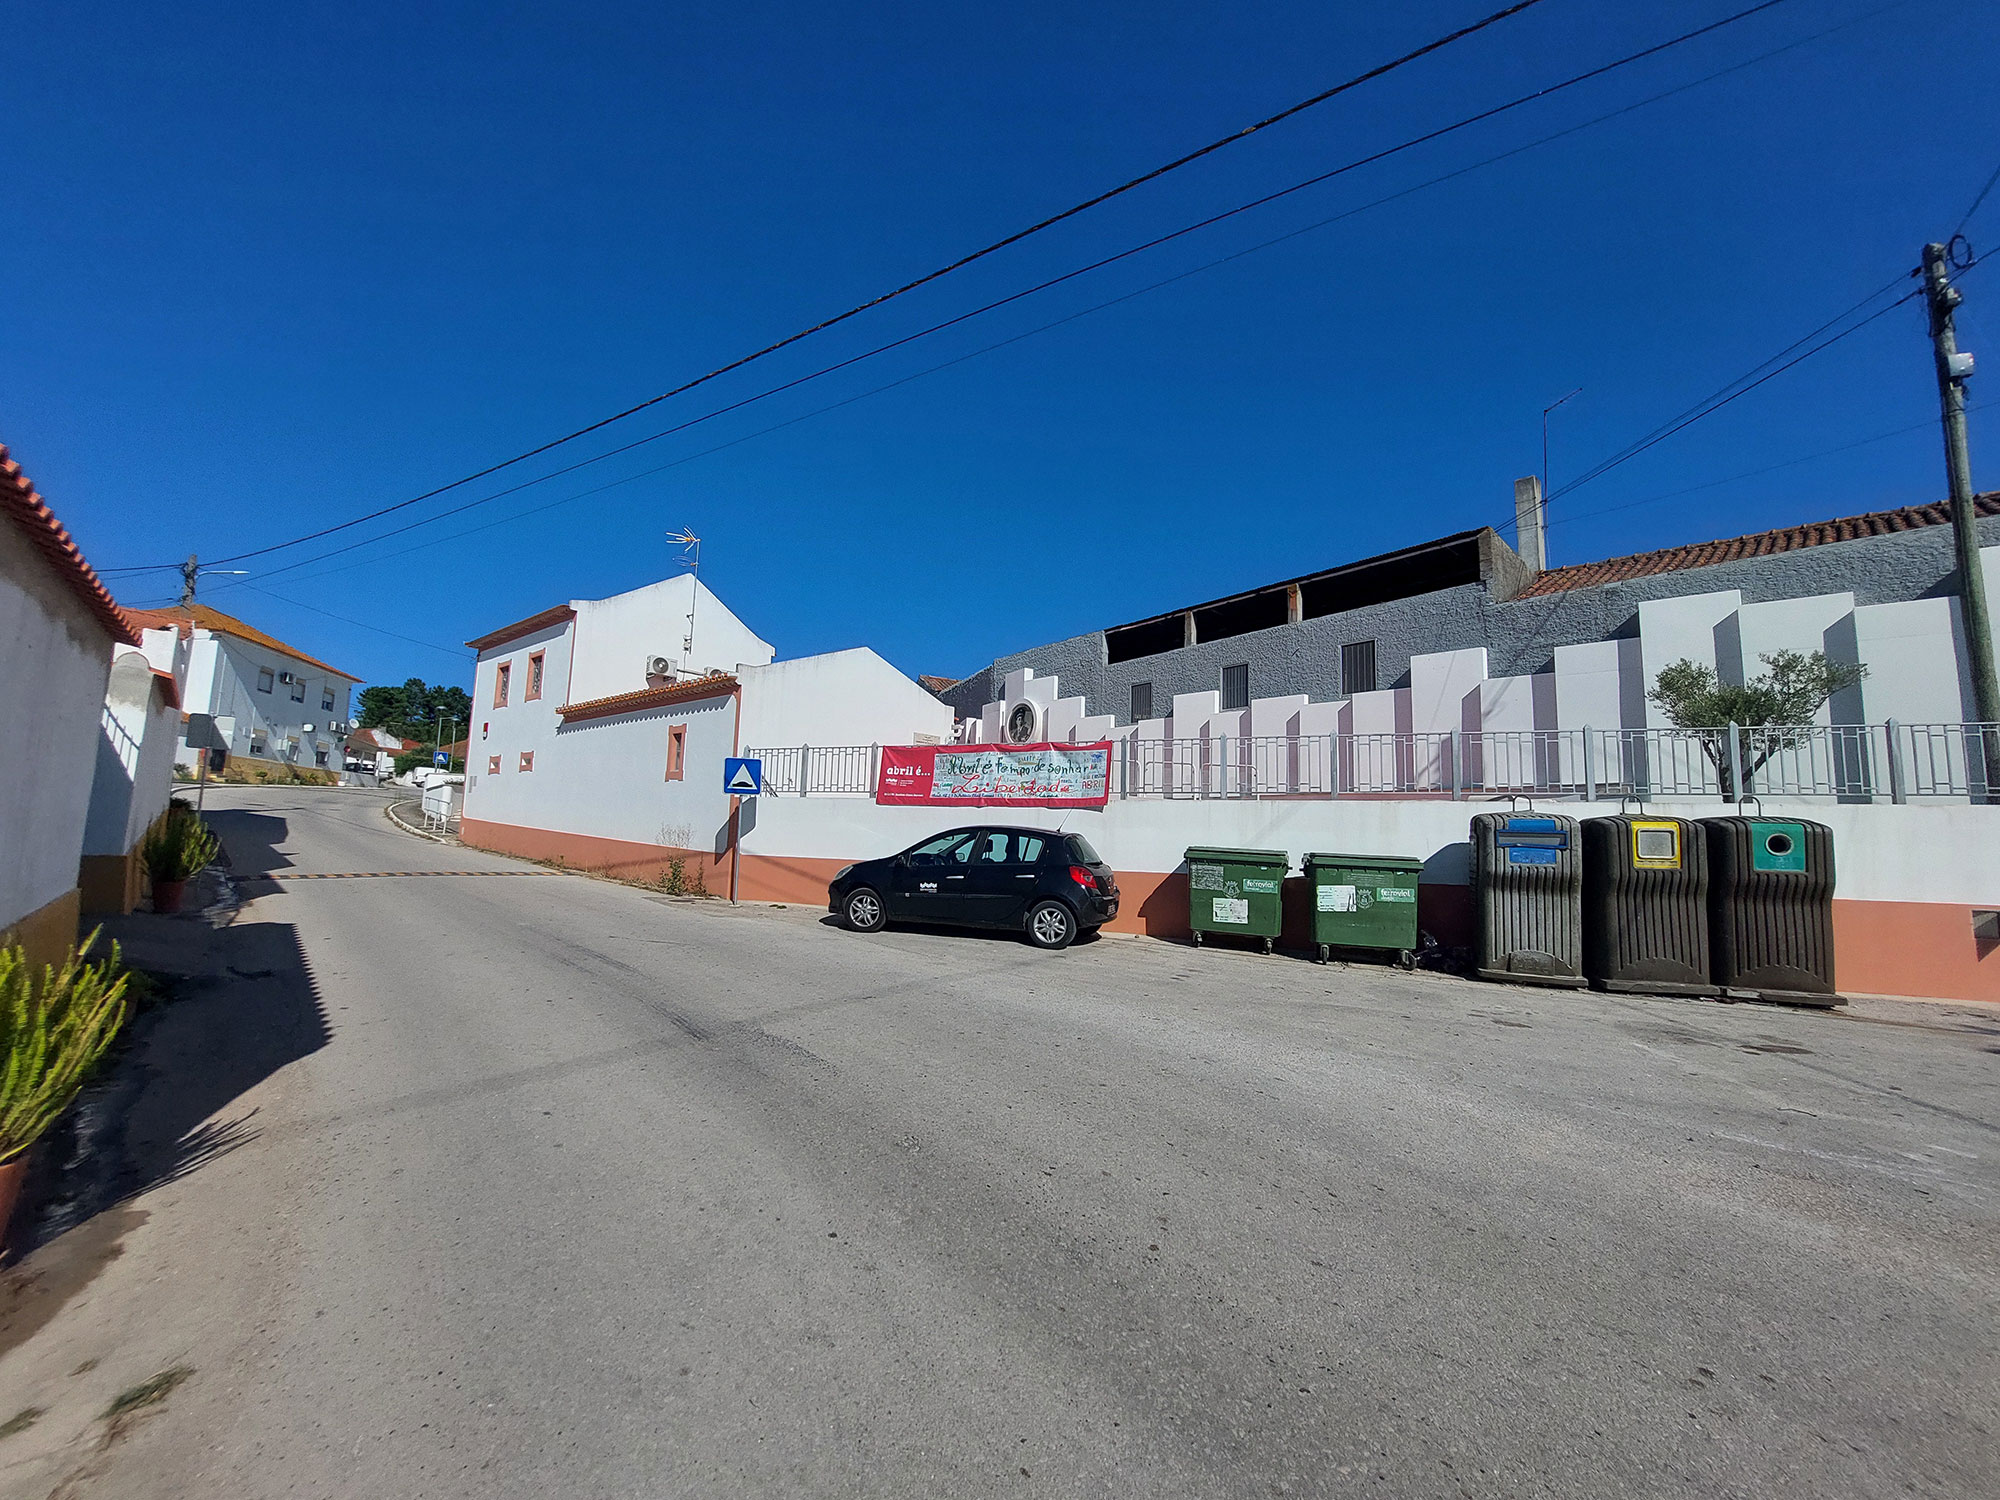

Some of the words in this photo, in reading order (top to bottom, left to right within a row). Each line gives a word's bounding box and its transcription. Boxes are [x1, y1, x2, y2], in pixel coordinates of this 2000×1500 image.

[886, 765, 913, 776] abril
[915, 765, 931, 776] é...
[947, 754, 981, 775] Abril
[982, 759, 993, 774] é
[995, 757, 1031, 777] tempo
[1033, 757, 1046, 773] de
[1048, 759, 1090, 775] sonhar
[952, 774, 1071, 794] Liberdade
[1246, 880, 1274, 889] ferrovial
[1380, 888, 1411, 898] ferrovial
